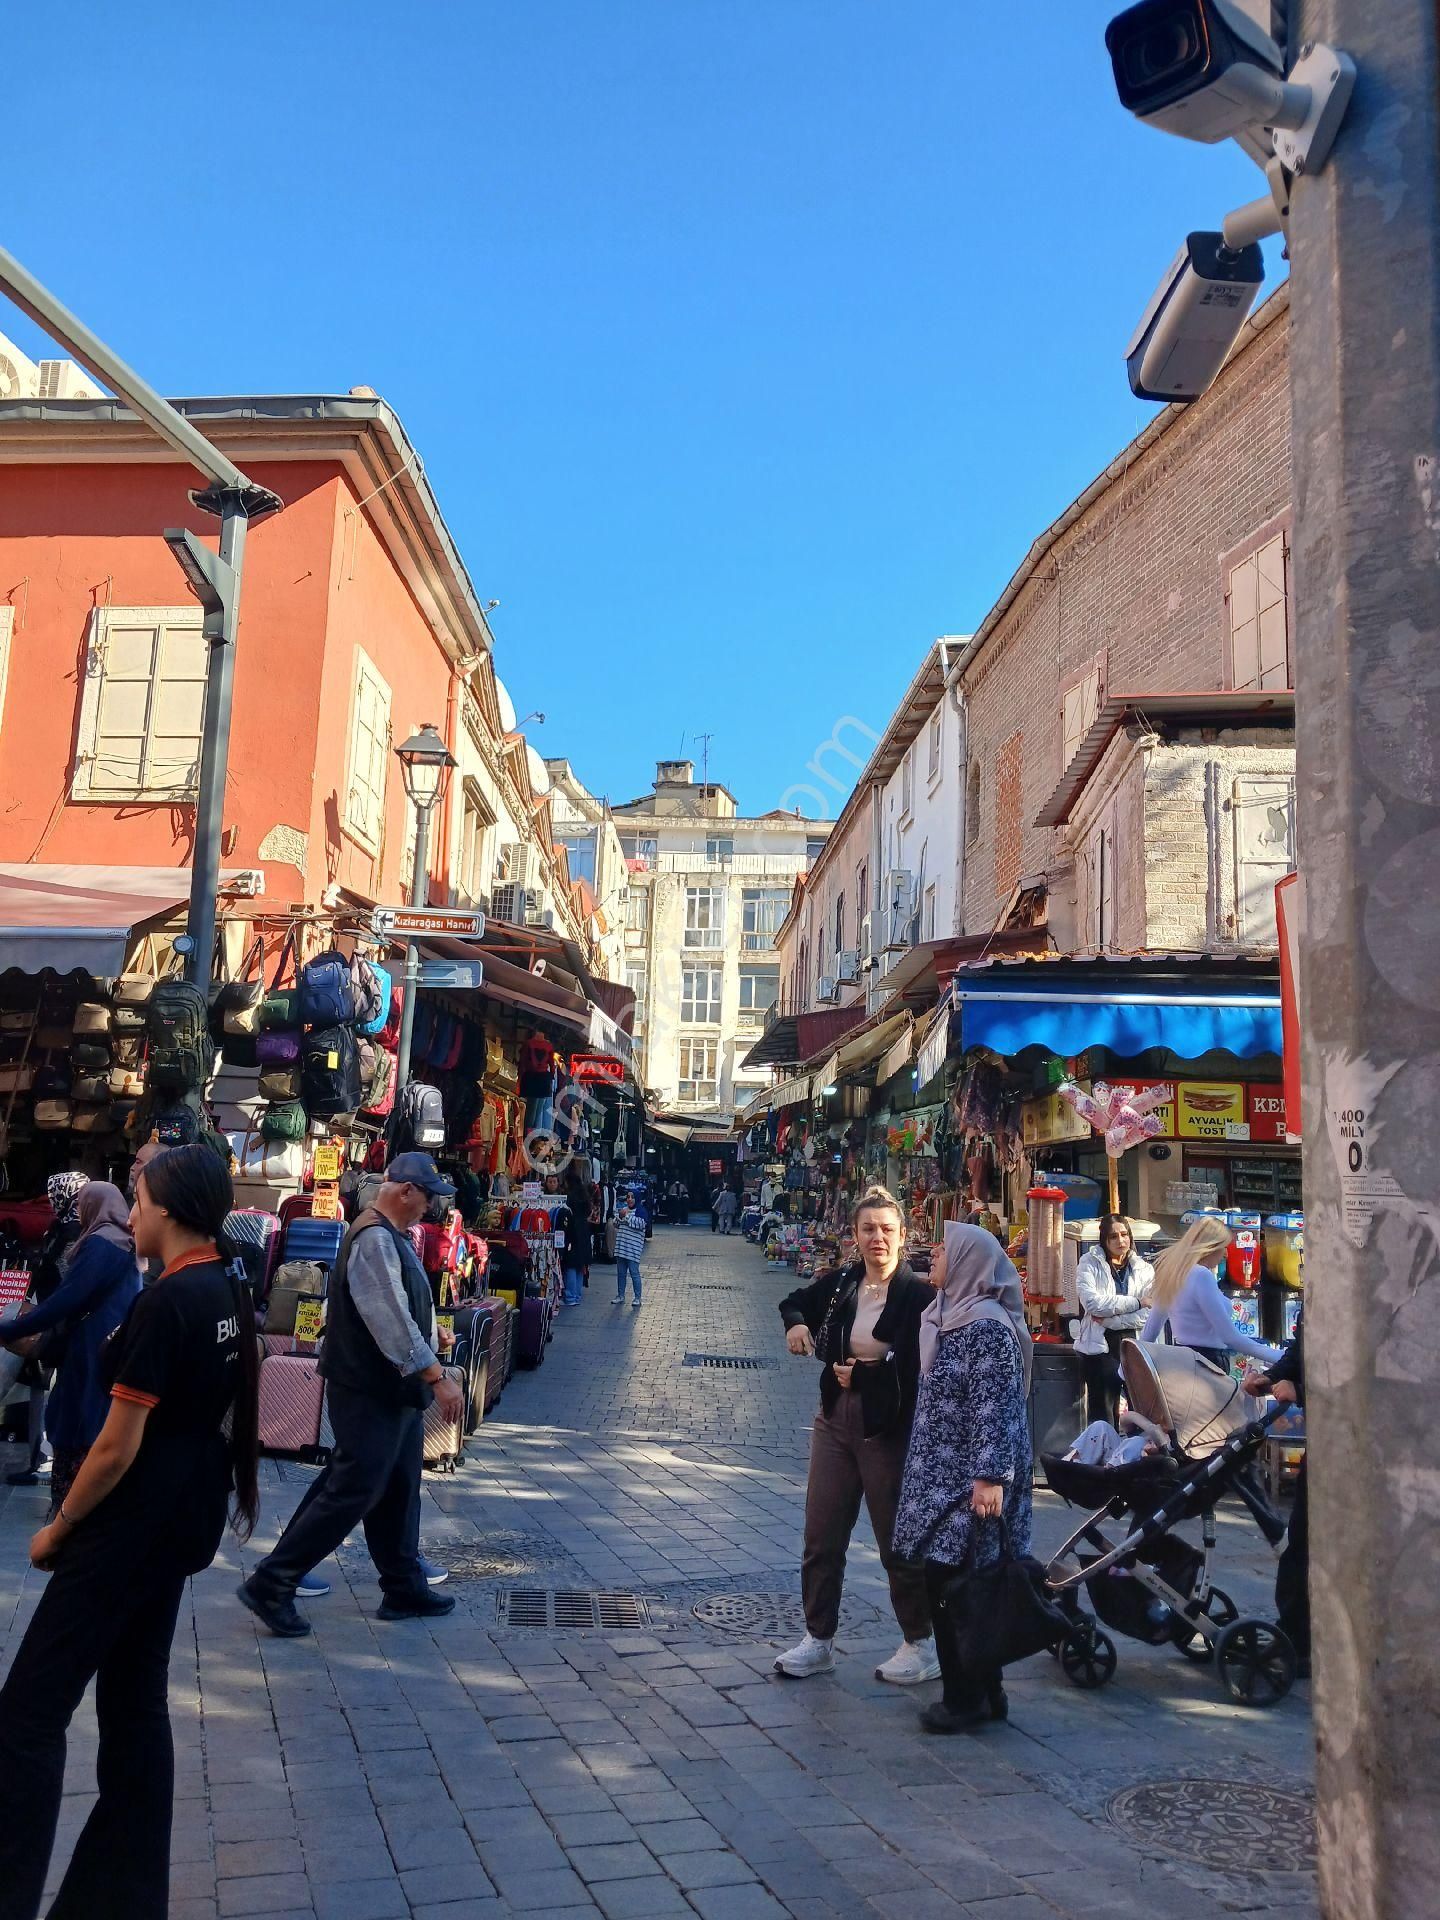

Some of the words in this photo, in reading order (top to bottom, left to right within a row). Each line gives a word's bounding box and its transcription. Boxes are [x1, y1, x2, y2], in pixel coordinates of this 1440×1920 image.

[394, 916, 443, 929] Kızlarağası
[446, 919, 467, 930] Hanı
[571, 1061, 621, 1076] MAYO
[1188, 1116, 1234, 1125] AYVALIK
[1198, 1126, 1225, 1135] TOST
[1229, 1125, 1248, 1135] 150
[1341, 1123, 1364, 1137] MİLY
[0, 1287, 25, 1296] NDİRİM
[216, 1315, 240, 1343] BU
